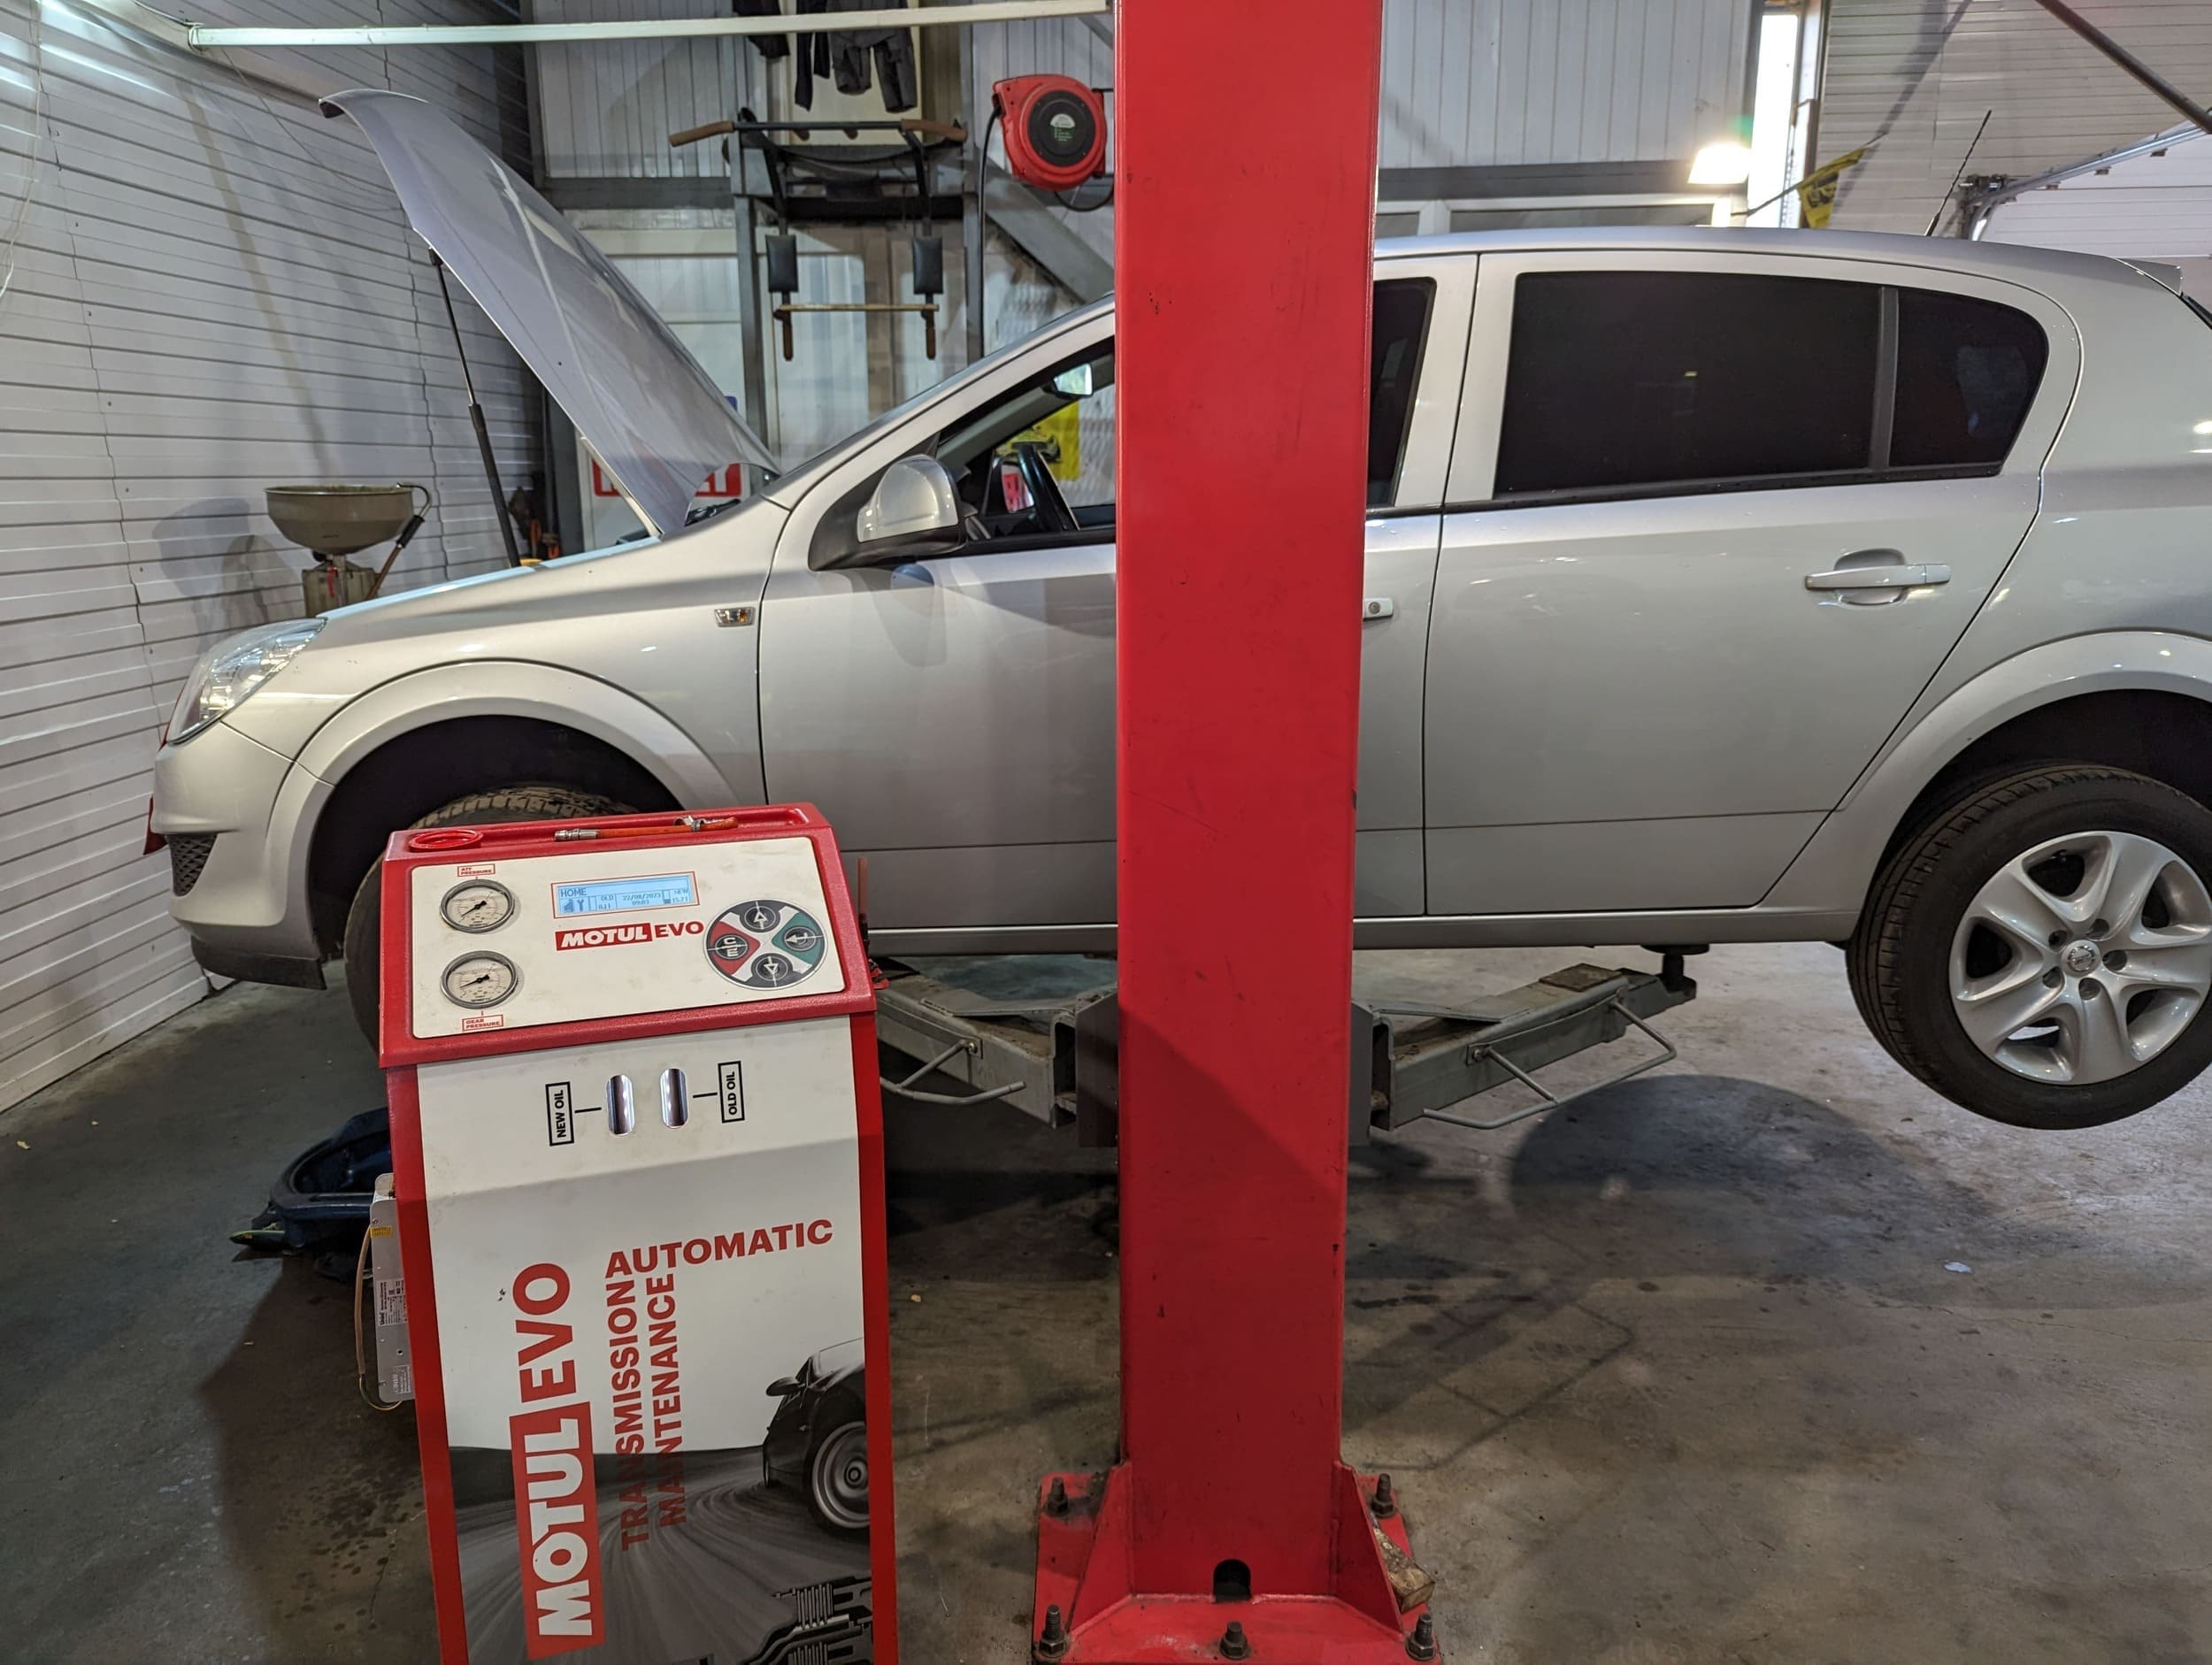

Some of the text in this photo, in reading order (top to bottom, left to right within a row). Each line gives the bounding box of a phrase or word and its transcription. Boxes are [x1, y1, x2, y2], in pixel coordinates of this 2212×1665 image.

[561, 887, 587, 897] HOME
[560, 921, 704, 948] MOTUL EVO
[555, 1089, 567, 1139] NEW OIL
[726, 1070, 738, 1116] OLD OIL
[604, 1219, 833, 1278] AUTOMATIC
[606, 1280, 650, 1551] TRANSMISSION
[645, 1273, 687, 1528] MAINTENANCE
[512, 1262, 594, 1637] MOTUL EVO
